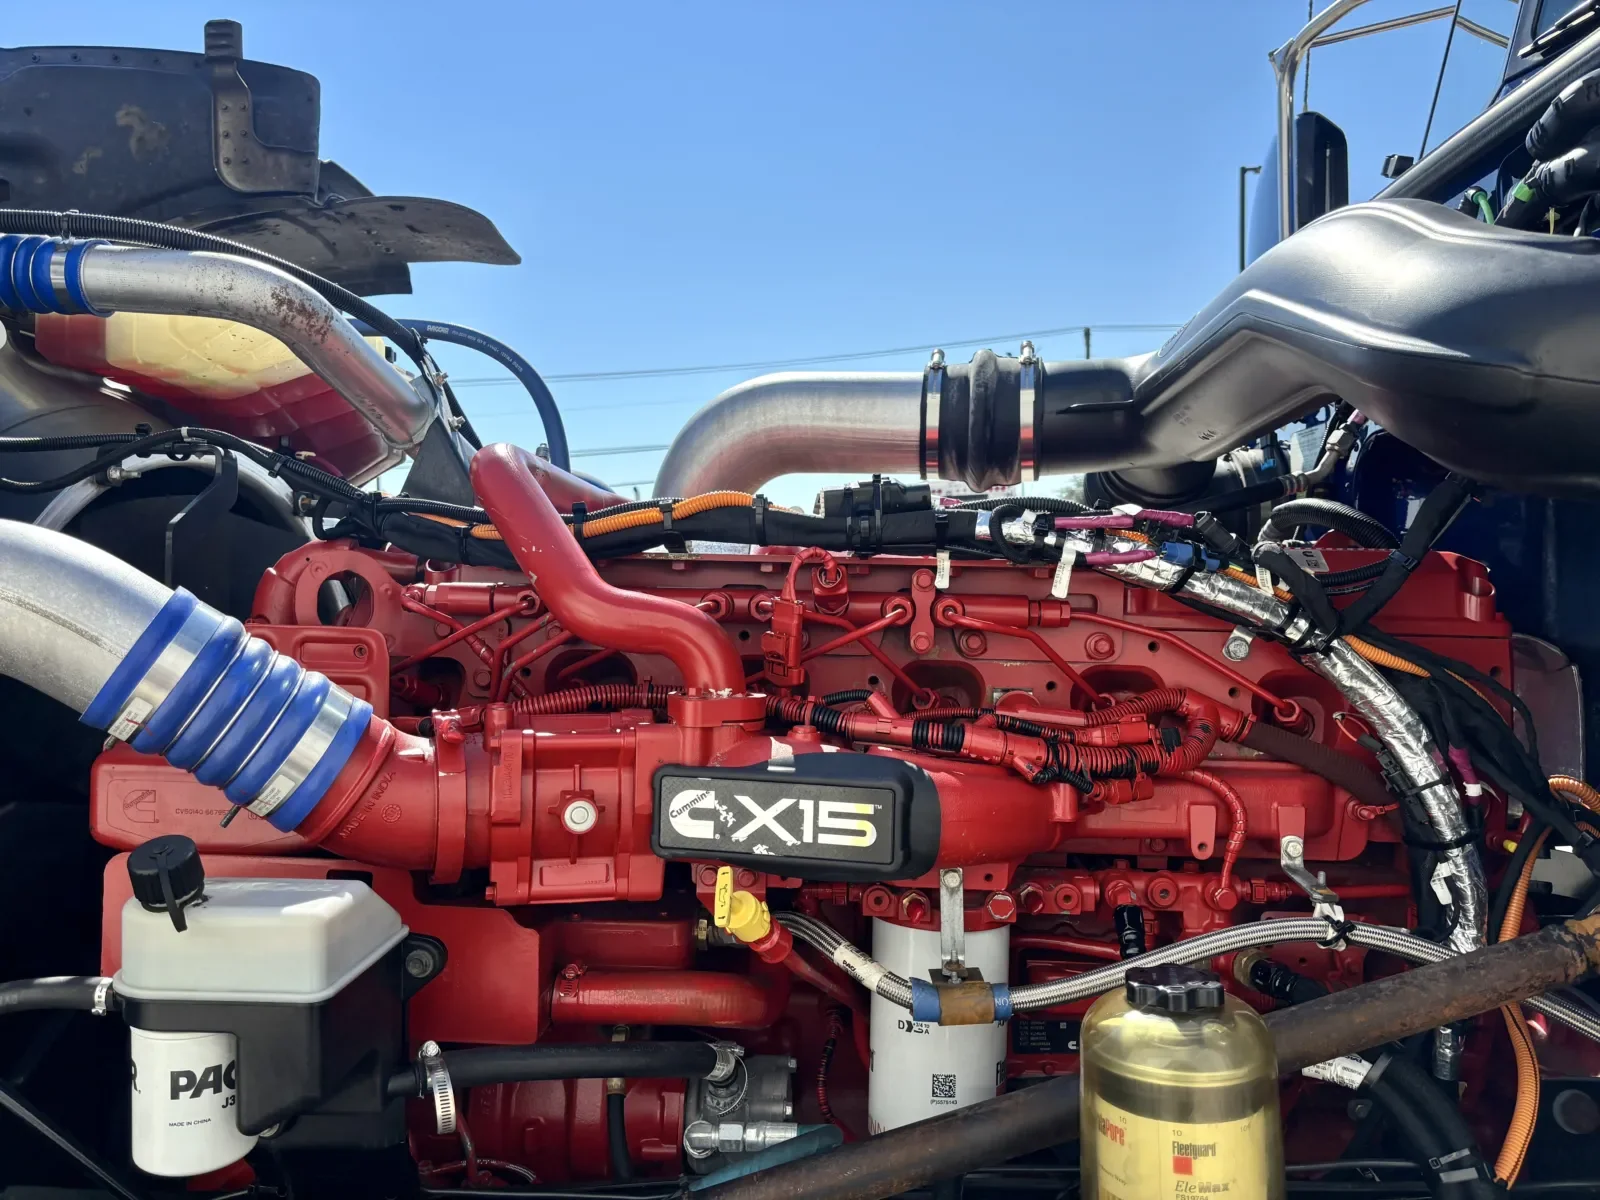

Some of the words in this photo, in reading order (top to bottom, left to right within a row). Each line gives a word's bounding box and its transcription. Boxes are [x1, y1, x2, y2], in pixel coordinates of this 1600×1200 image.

[339, 812, 365, 839] MADE
[365, 802, 376, 814] IN
[374, 771, 396, 802] INDIA
[193, 1117, 212, 1125] CHINA
[1172, 1129, 1183, 1137] 10
[1172, 1140, 1217, 1160] Fleetguard
